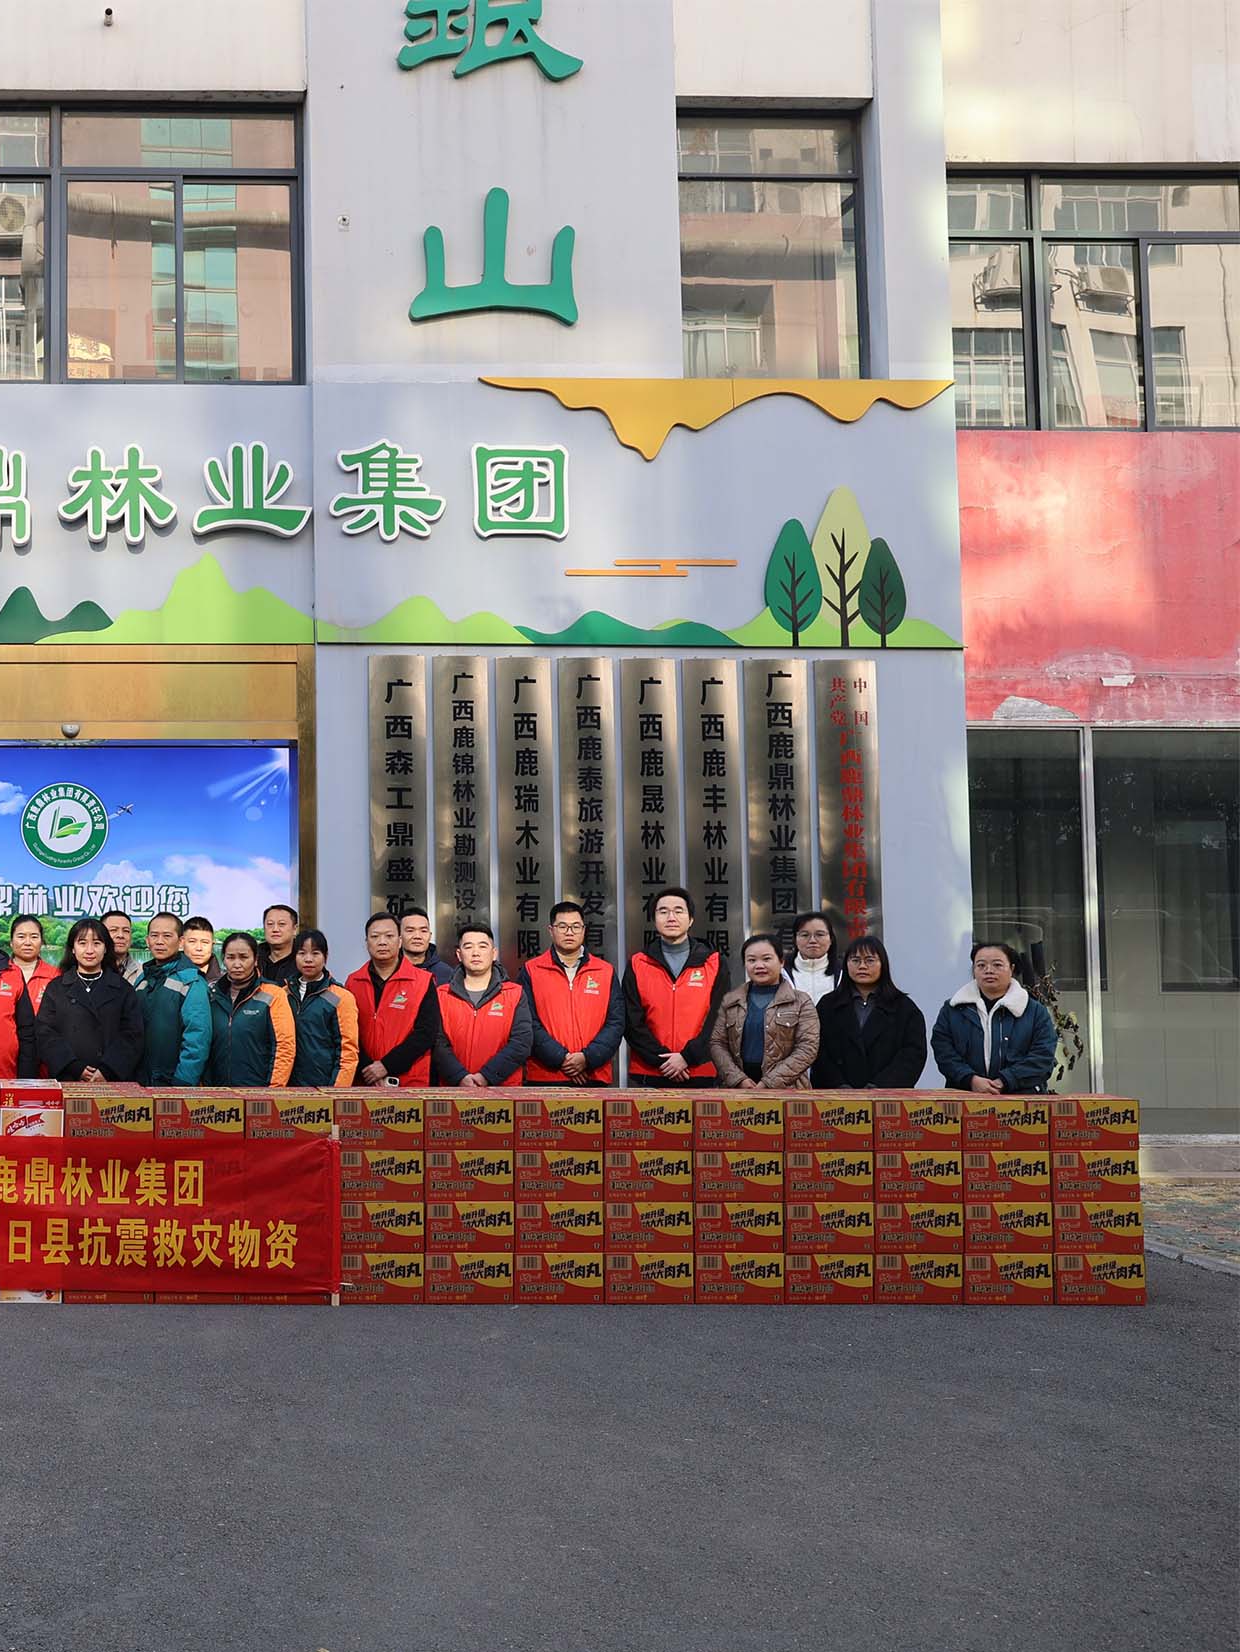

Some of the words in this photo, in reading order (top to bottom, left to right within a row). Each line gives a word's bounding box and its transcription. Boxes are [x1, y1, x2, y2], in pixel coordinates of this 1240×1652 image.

[513, 676, 541, 958] 广西鹿瑞木业有限
